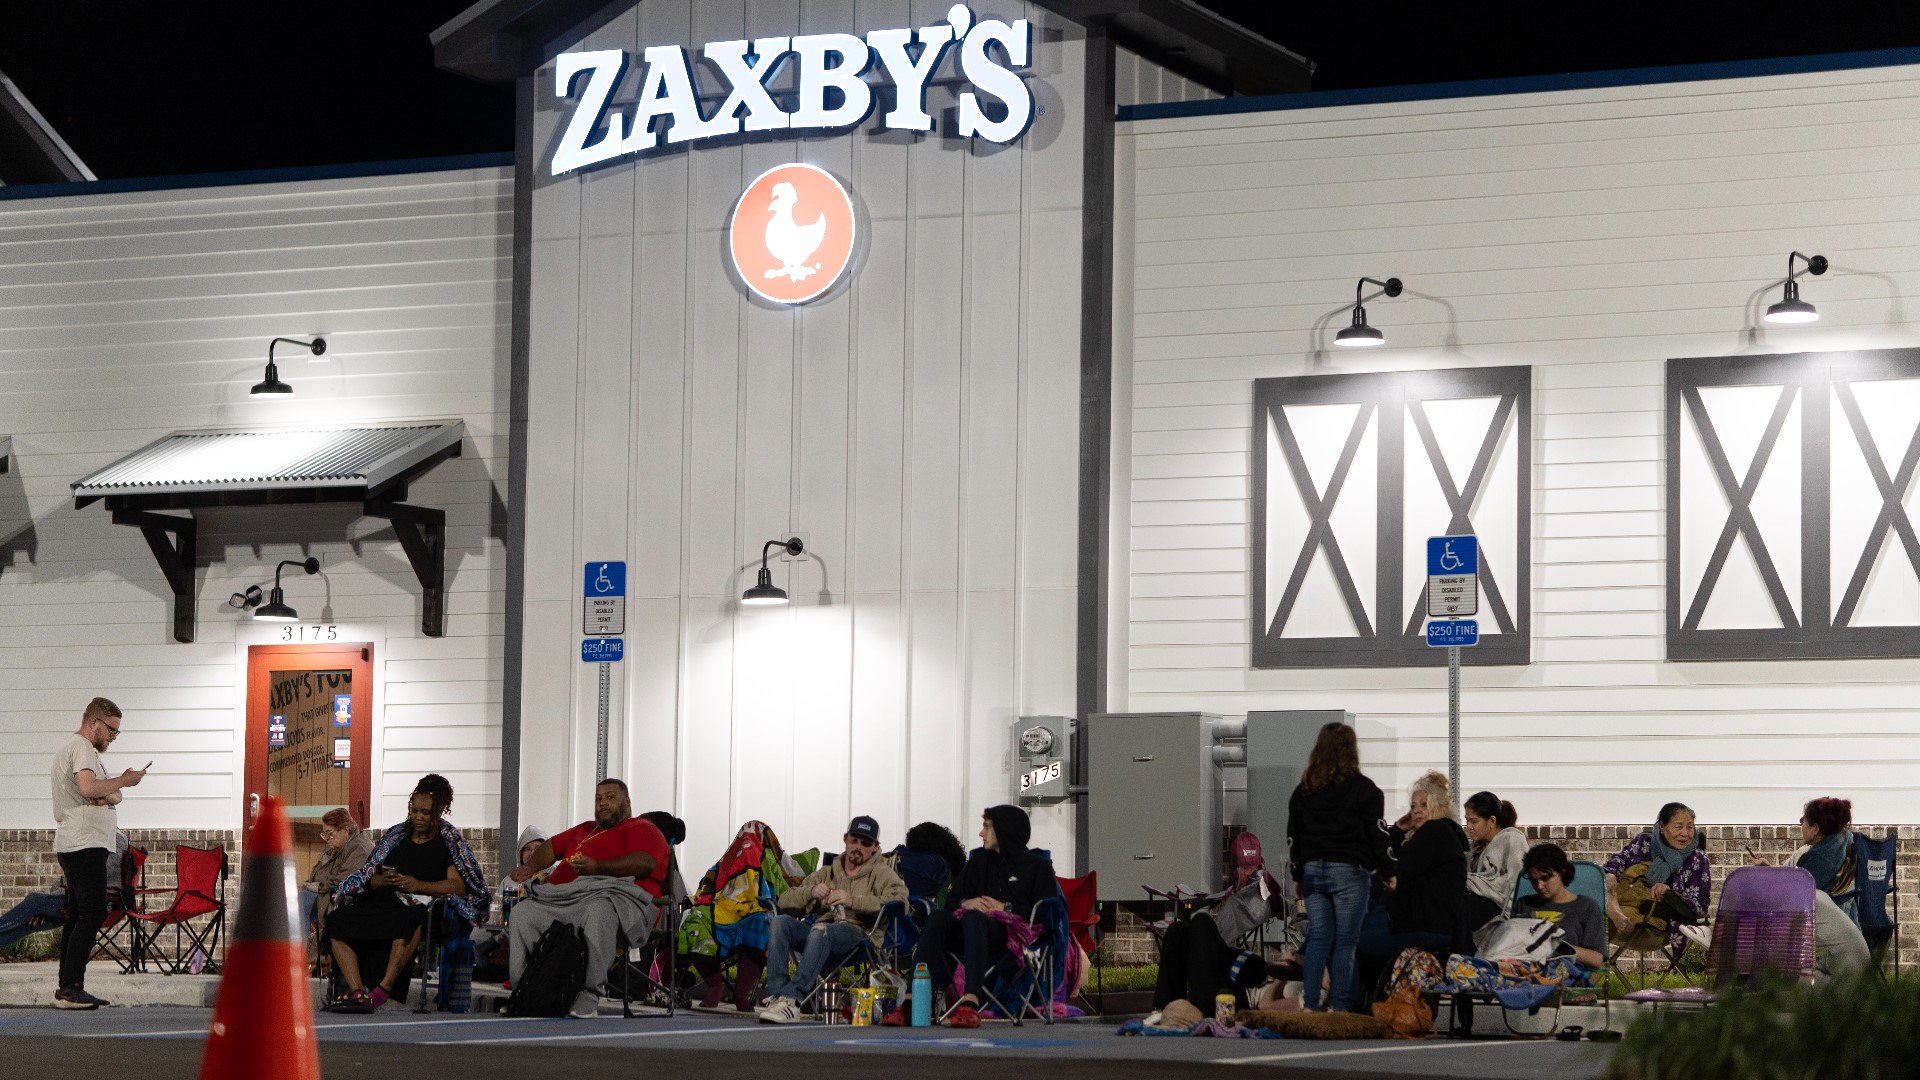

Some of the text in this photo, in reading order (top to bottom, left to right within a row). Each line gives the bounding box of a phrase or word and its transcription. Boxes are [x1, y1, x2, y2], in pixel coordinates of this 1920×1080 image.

[550, 3, 1033, 176] ZAXBY'S
[282, 625, 337, 642] 3175
[1429, 625, 1475, 637] $250 FINE
[583, 642, 622, 654] $250 FINE
[311, 753, 335, 774] TIMES
[1022, 763, 1058, 788] 3175
